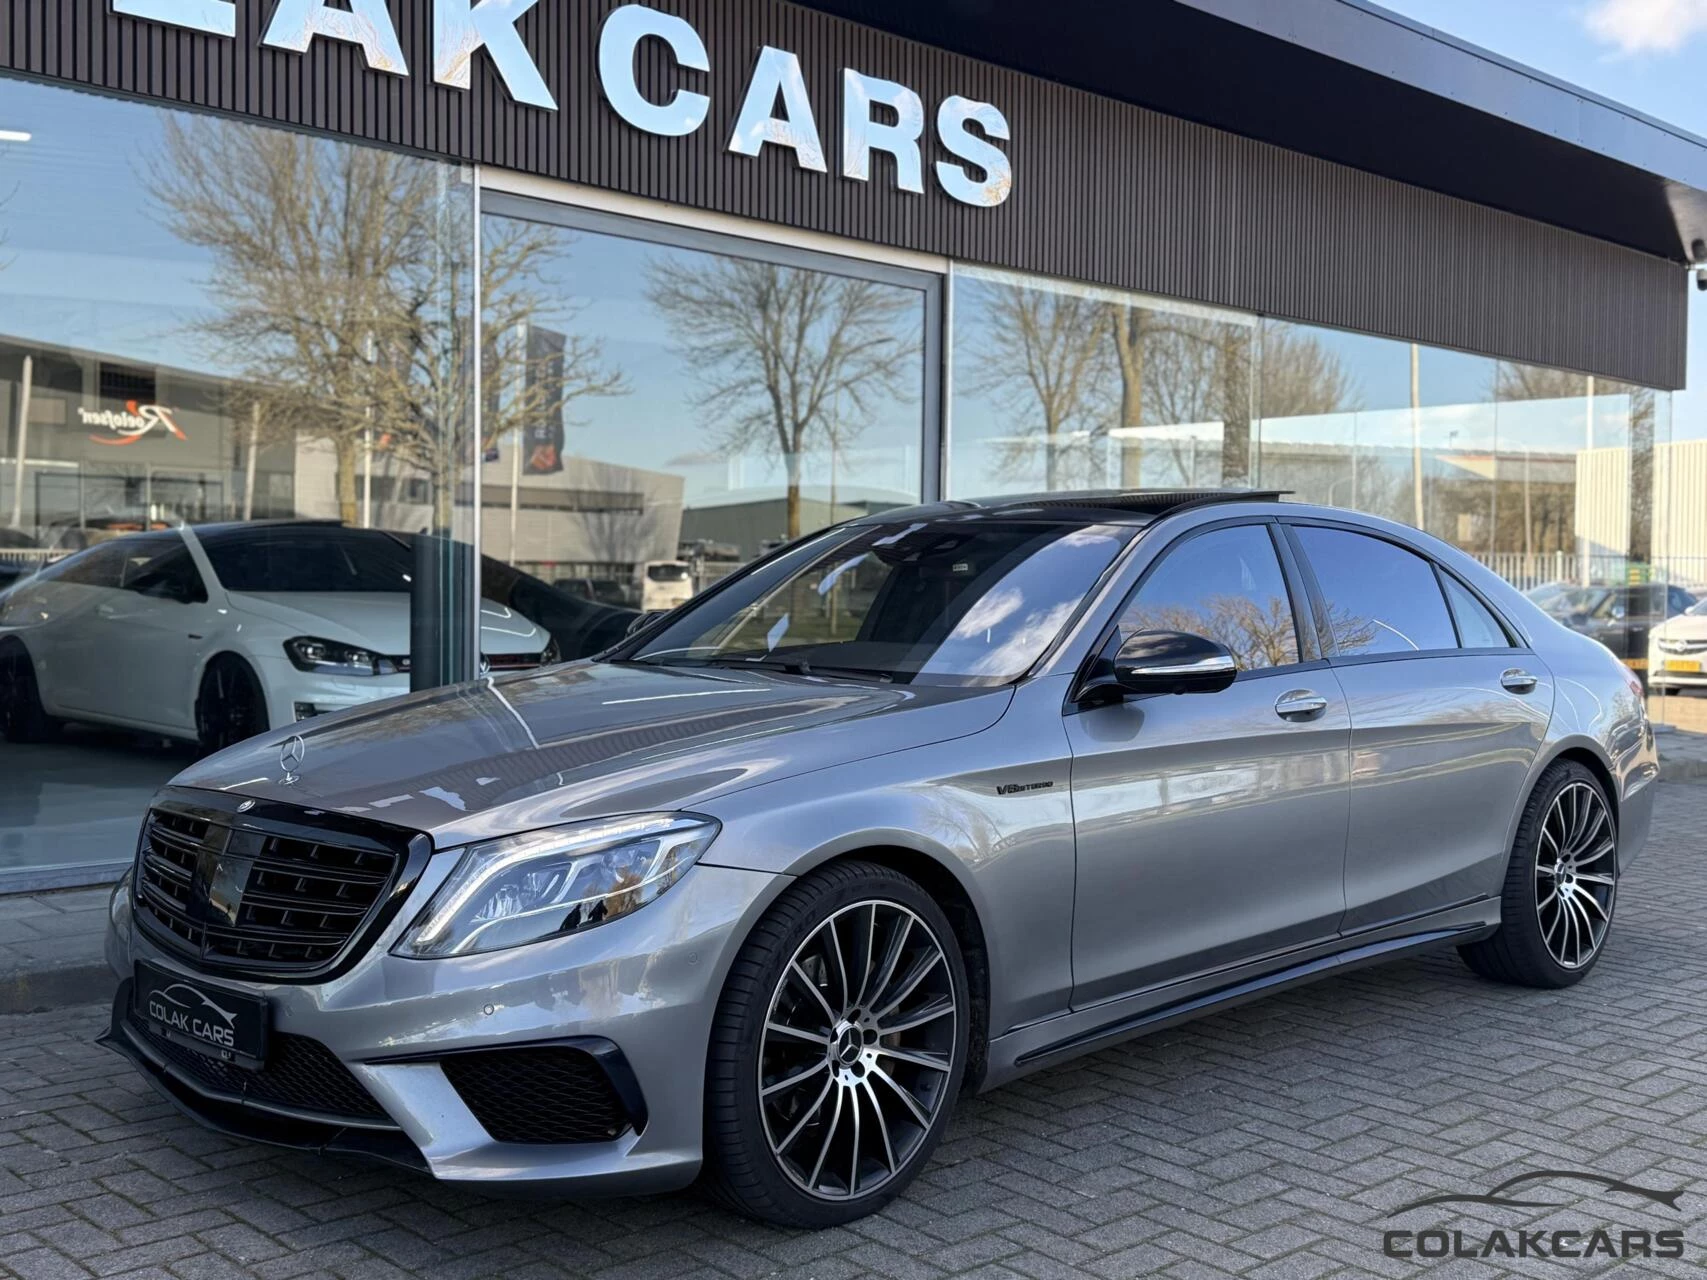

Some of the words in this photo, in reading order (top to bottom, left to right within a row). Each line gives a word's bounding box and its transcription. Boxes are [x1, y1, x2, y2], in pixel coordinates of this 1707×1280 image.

[598, 3, 1012, 208] CARS
[149, 1000, 190, 1032] COLAK
[192, 1017, 234, 1047] CARS
